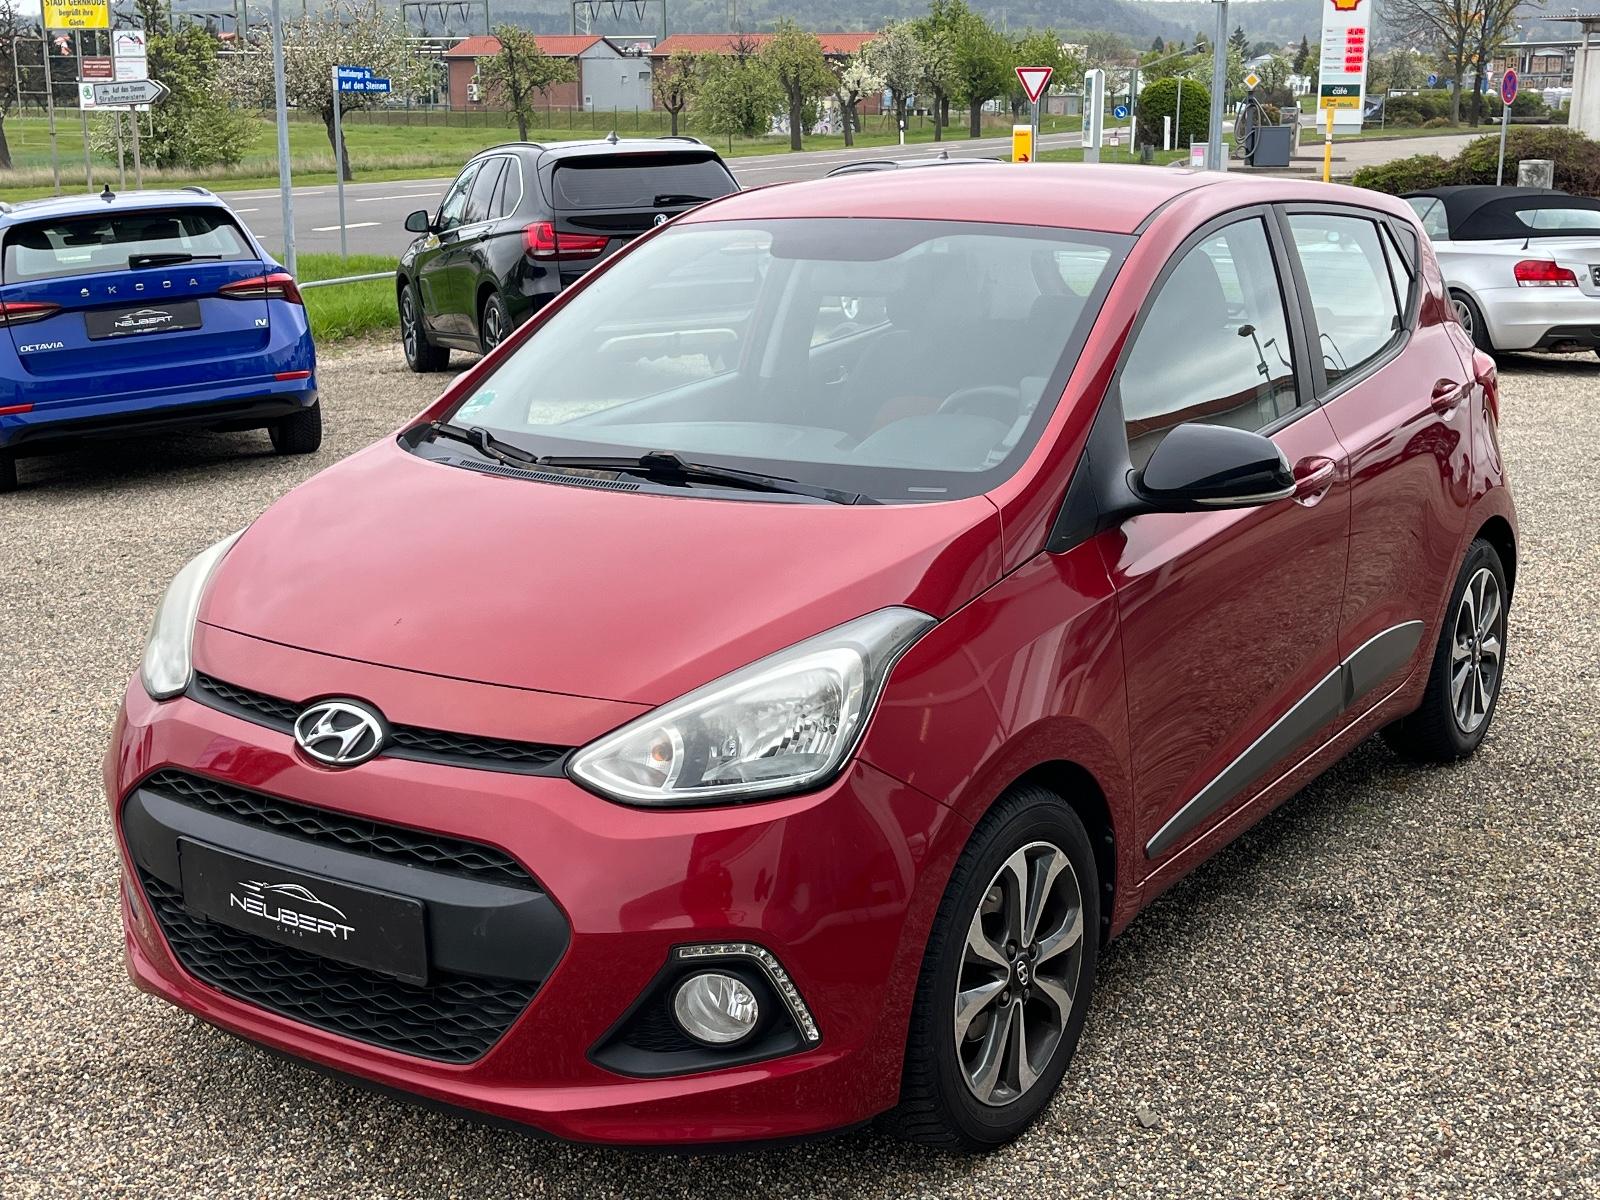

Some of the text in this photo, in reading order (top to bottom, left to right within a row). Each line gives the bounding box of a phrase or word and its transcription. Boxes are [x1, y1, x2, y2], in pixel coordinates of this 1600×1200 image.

[341, 80, 387, 90] Auf den Steinen
[114, 315, 174, 328] NEUBERT
[20, 341, 64, 352] OCTAVIA
[229, 892, 356, 940] NEUBERT
